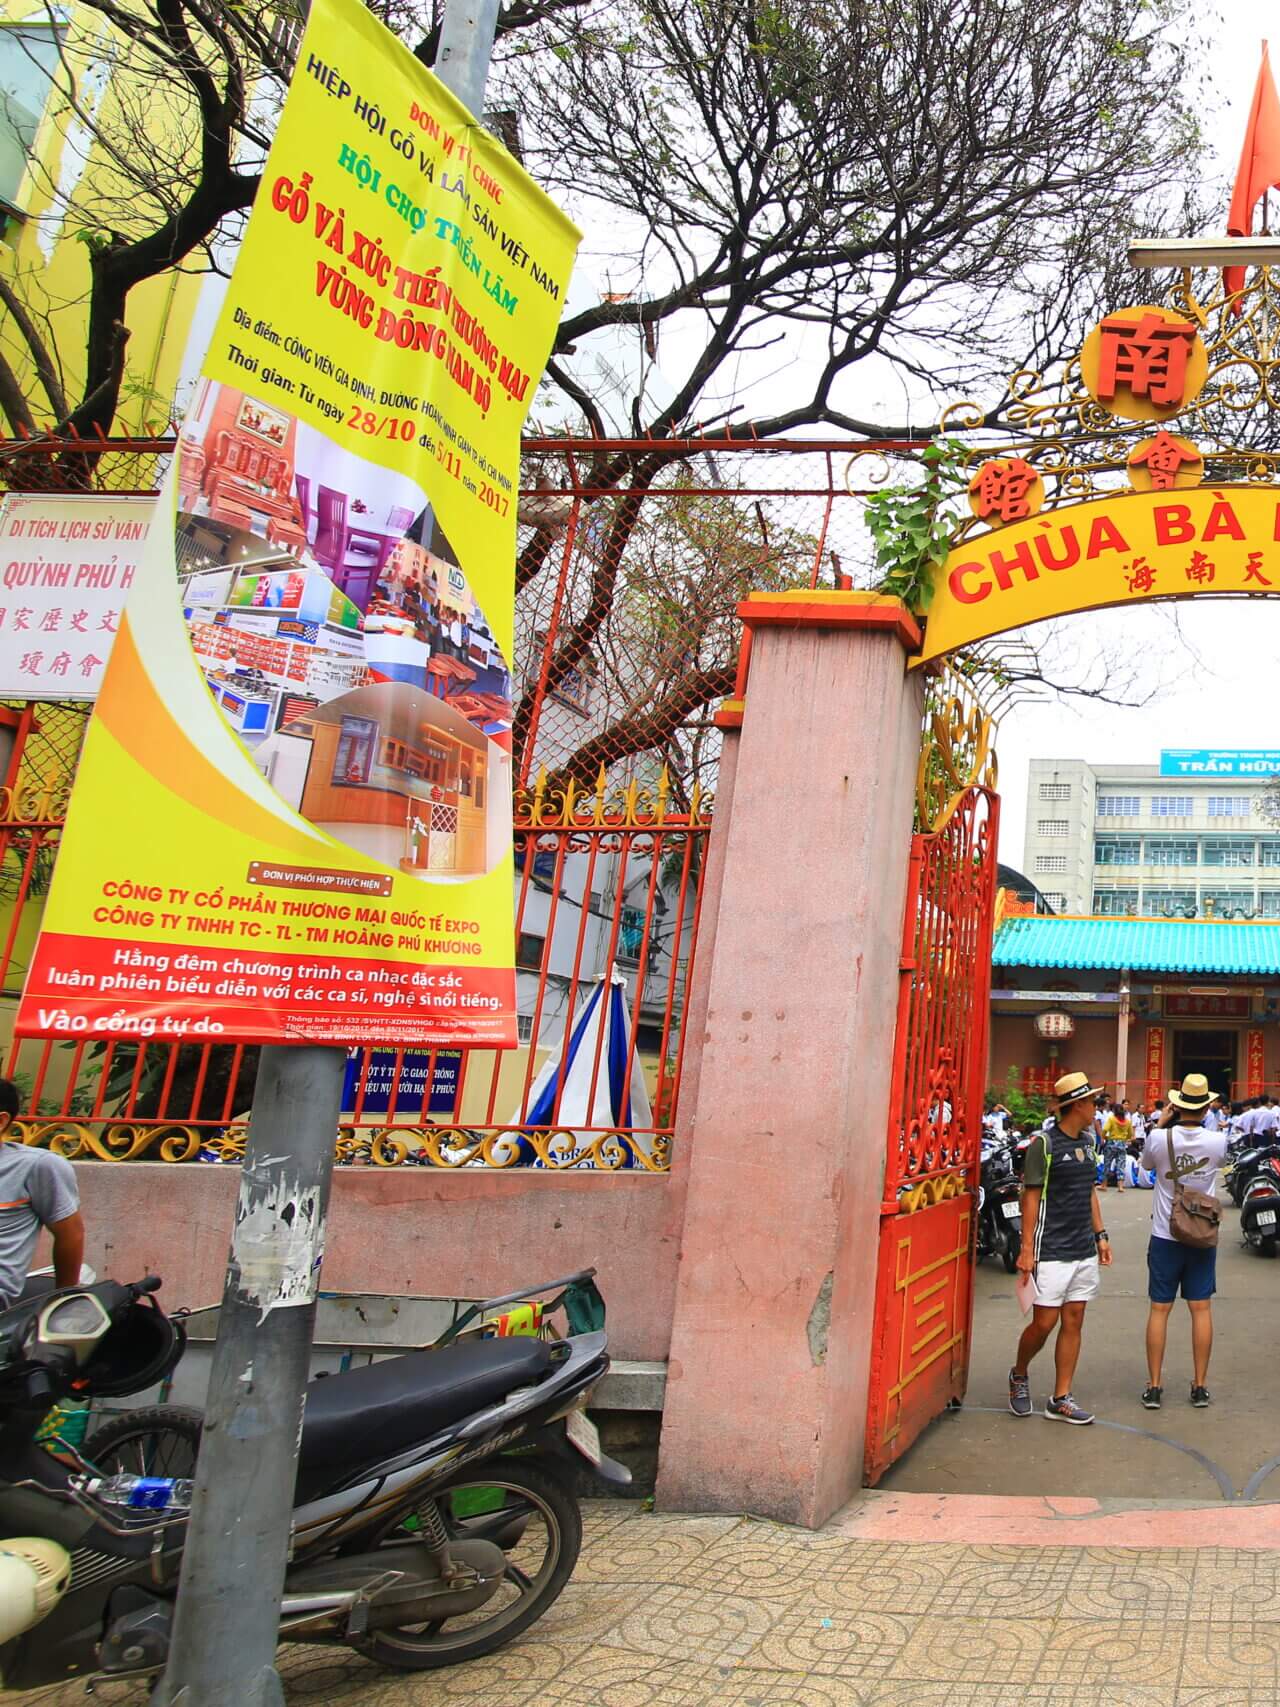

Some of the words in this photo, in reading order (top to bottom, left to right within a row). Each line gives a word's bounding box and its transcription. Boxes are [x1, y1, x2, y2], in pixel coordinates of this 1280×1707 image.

[409, 101, 440, 141] ĐƠN
[443, 131, 455, 158] VỊ
[307, 54, 351, 100] HIỆP
[353, 95, 386, 136] HỘI
[390, 130, 416, 160] GỖ
[420, 150, 436, 183] VÀ
[472, 203, 498, 240] SẢN
[500, 232, 530, 269] VIỆT
[530, 262, 559, 300] NAM
[338, 143, 382, 193] HỘI
[385, 183, 427, 235] CHỢ
[482, 270, 518, 316] LÃM
[272, 171, 314, 224] GỖ
[315, 202, 345, 254] VÀ
[347, 231, 391, 288] XÚC
[393, 266, 452, 316] TIẾN
[451, 296, 498, 373] THƯƠNG
[498, 356, 530, 402] MẠI
[233, 307, 251, 331] Địa
[253, 321, 282, 347] điểm:
[284, 334, 313, 364] CÔNG
[314, 354, 334, 378] VIÊN
[335, 367, 349, 388] GIA
[351, 377, 376, 403] ĐỊNH,
[316, 261, 375, 330] VÙNG
[375, 307, 447, 360] ĐÔNG
[446, 339, 474, 396] NAM
[473, 372, 491, 420] BỘ
[227, 344, 258, 371] Thời
[261, 367, 295, 394] gian:
[299, 382, 314, 405] Từ
[317, 397, 345, 424] ngày
[347, 405, 416, 442] 28/10
[419, 434, 436, 456] đến
[436, 440, 461, 480] 5/11
[478, 481, 509, 517] 2017
[9, 520, 24, 537] DI
[28, 516, 57, 538] TÍCH
[59, 521, 90, 542] LỊCH
[92, 516, 114, 539] SỬ
[115, 519, 144, 540] VĂN
[948, 515, 1131, 604] CHÙA
[1152, 492, 1247, 546] BÀ
[3, 556, 72, 590] QUỲNH
[74, 555, 117, 589] PHỦ
[0, 607, 120, 632] 家歷史文
[94, 905, 154, 927] CÔNG
[161, 913, 181, 929] TY
[186, 916, 234, 934] TNHH
[239, 921, 262, 937] TC
[276, 925, 292, 940] TL
[306, 927, 329, 943] TM
[333, 929, 394, 948] HOÀNG
[398, 934, 421, 951] PHÚ
[424, 939, 482, 955] KHƯƠNG
[102, 880, 163, 902] CÔNG
[168, 888, 189, 904] TY
[194, 886, 224, 909] CỔ
[227, 891, 276, 914] PHẦN
[282, 901, 351, 920] THƯƠNG
[355, 907, 386, 927] MẠI
[391, 910, 426, 930] QUỐC
[429, 913, 444, 931] TẾ
[445, 919, 480, 934] EXPO
[47, 967, 95, 986] luân
[100, 970, 161, 991] phiên
[166, 976, 211, 994] biểu
[215, 978, 257, 997] diễn
[262, 983, 290, 1000] với
[294, 982, 324, 1002] các
[327, 988, 347, 1002] ca
[351, 987, 369, 1005] sĩ,
[373, 990, 416, 1009] nghệ
[433, 991, 457, 1007] nổi
[460, 993, 503, 1011] tiếng.
[113, 948, 170, 971] Hằng
[174, 953, 218, 971] đêm
[222, 958, 293, 981] chương
[297, 964, 342, 981] trình
[345, 969, 364, 982] ca
[368, 968, 409, 987] nhạc
[411, 971, 435, 988] đặc
[439, 972, 463, 987] sắc
[38, 1008, 88, 1032] Vào
[93, 1008, 156, 1037] cổng
[162, 1015, 190, 1038] tự
[192, 1016, 225, 1033] do
